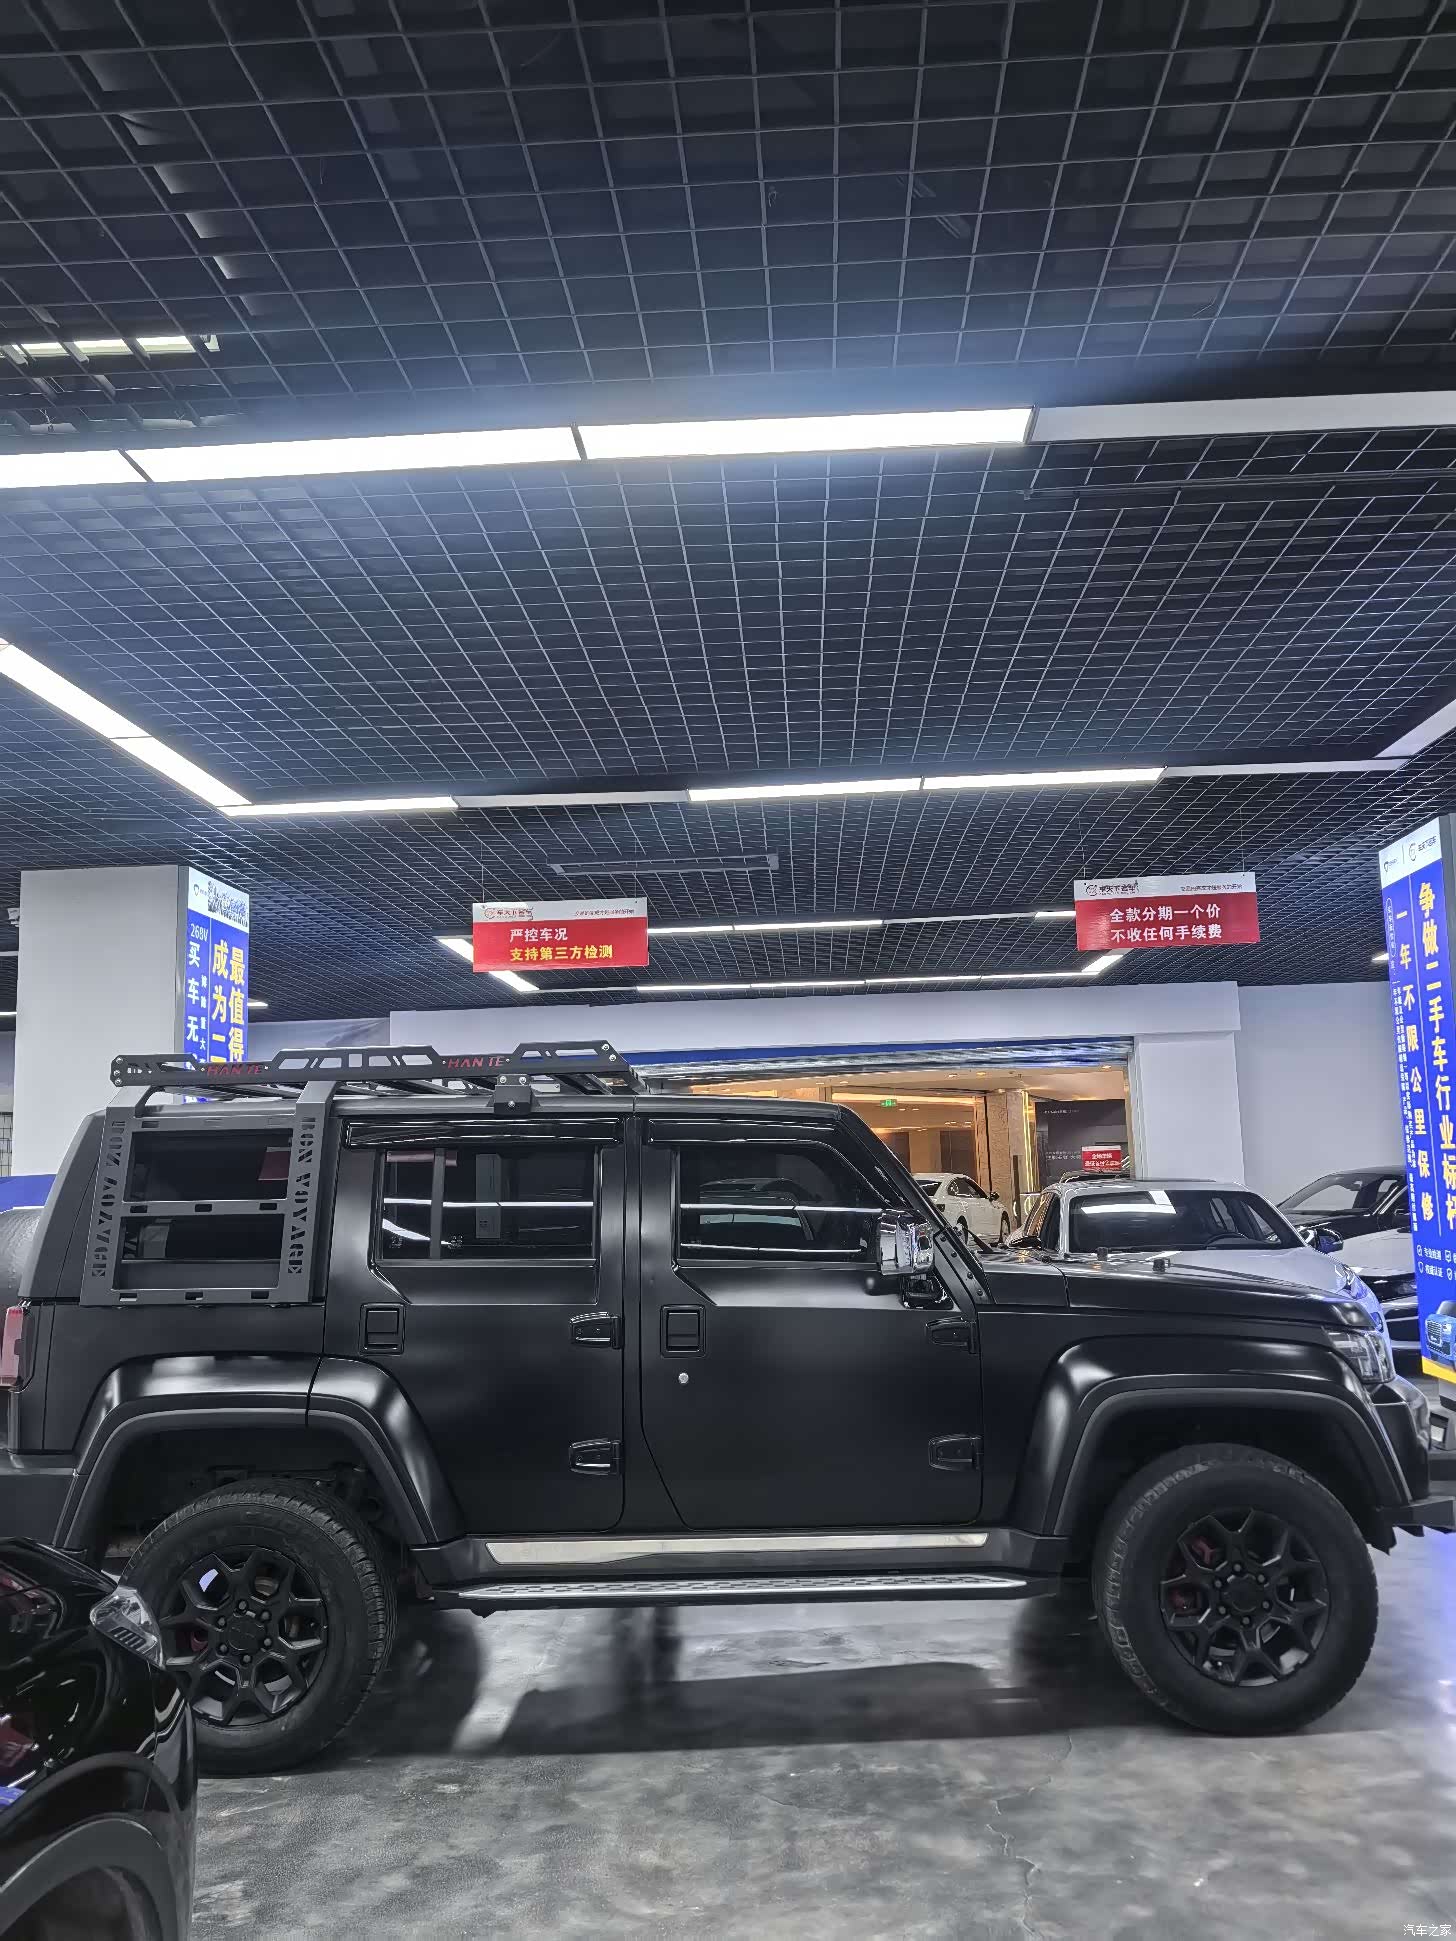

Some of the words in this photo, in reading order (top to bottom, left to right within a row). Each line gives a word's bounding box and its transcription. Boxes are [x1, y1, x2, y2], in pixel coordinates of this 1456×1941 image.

[1109, 903, 1221, 923] 全款分期一个价
[509, 927, 569, 943] 严控车况
[1110, 924, 1223, 943] 不收任何手续费
[509, 944, 614, 962] 支持第三方检测
[228, 947, 246, 1062] 最值得
[448, 1056, 484, 1069] HAN
[1396, 910, 1434, 1222] 一年不限公里保修
[287, 1172, 311, 1274] VOYAGE
